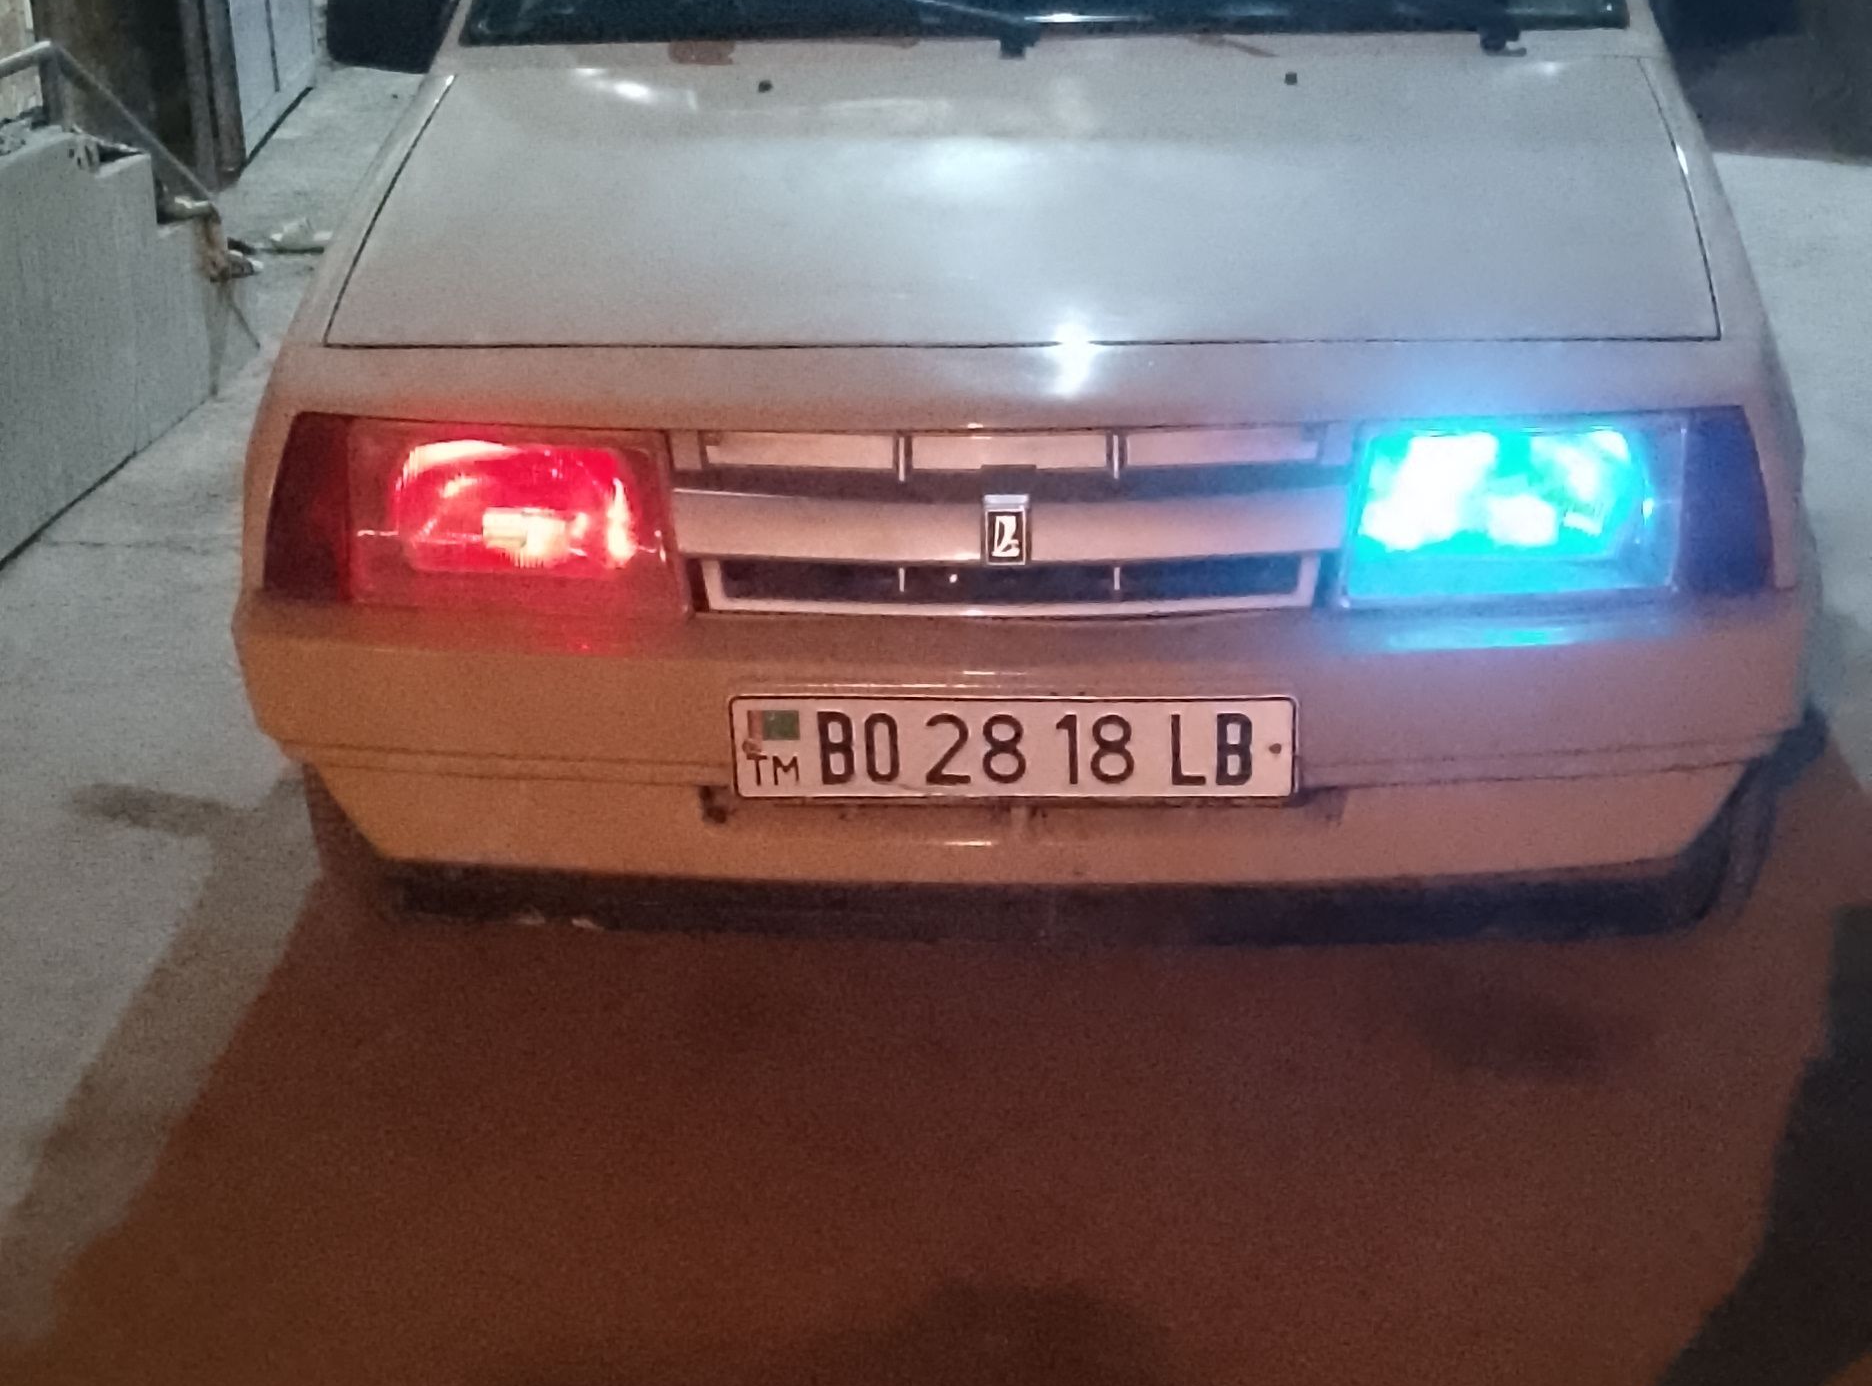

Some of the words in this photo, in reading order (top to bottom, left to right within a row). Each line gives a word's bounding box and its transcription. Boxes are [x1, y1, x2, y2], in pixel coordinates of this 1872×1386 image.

[748, 755, 800, 787] TM
[925, 713, 1027, 786] 28
[1055, 713, 1135, 786] 18
[1170, 712, 1253, 787] LB
